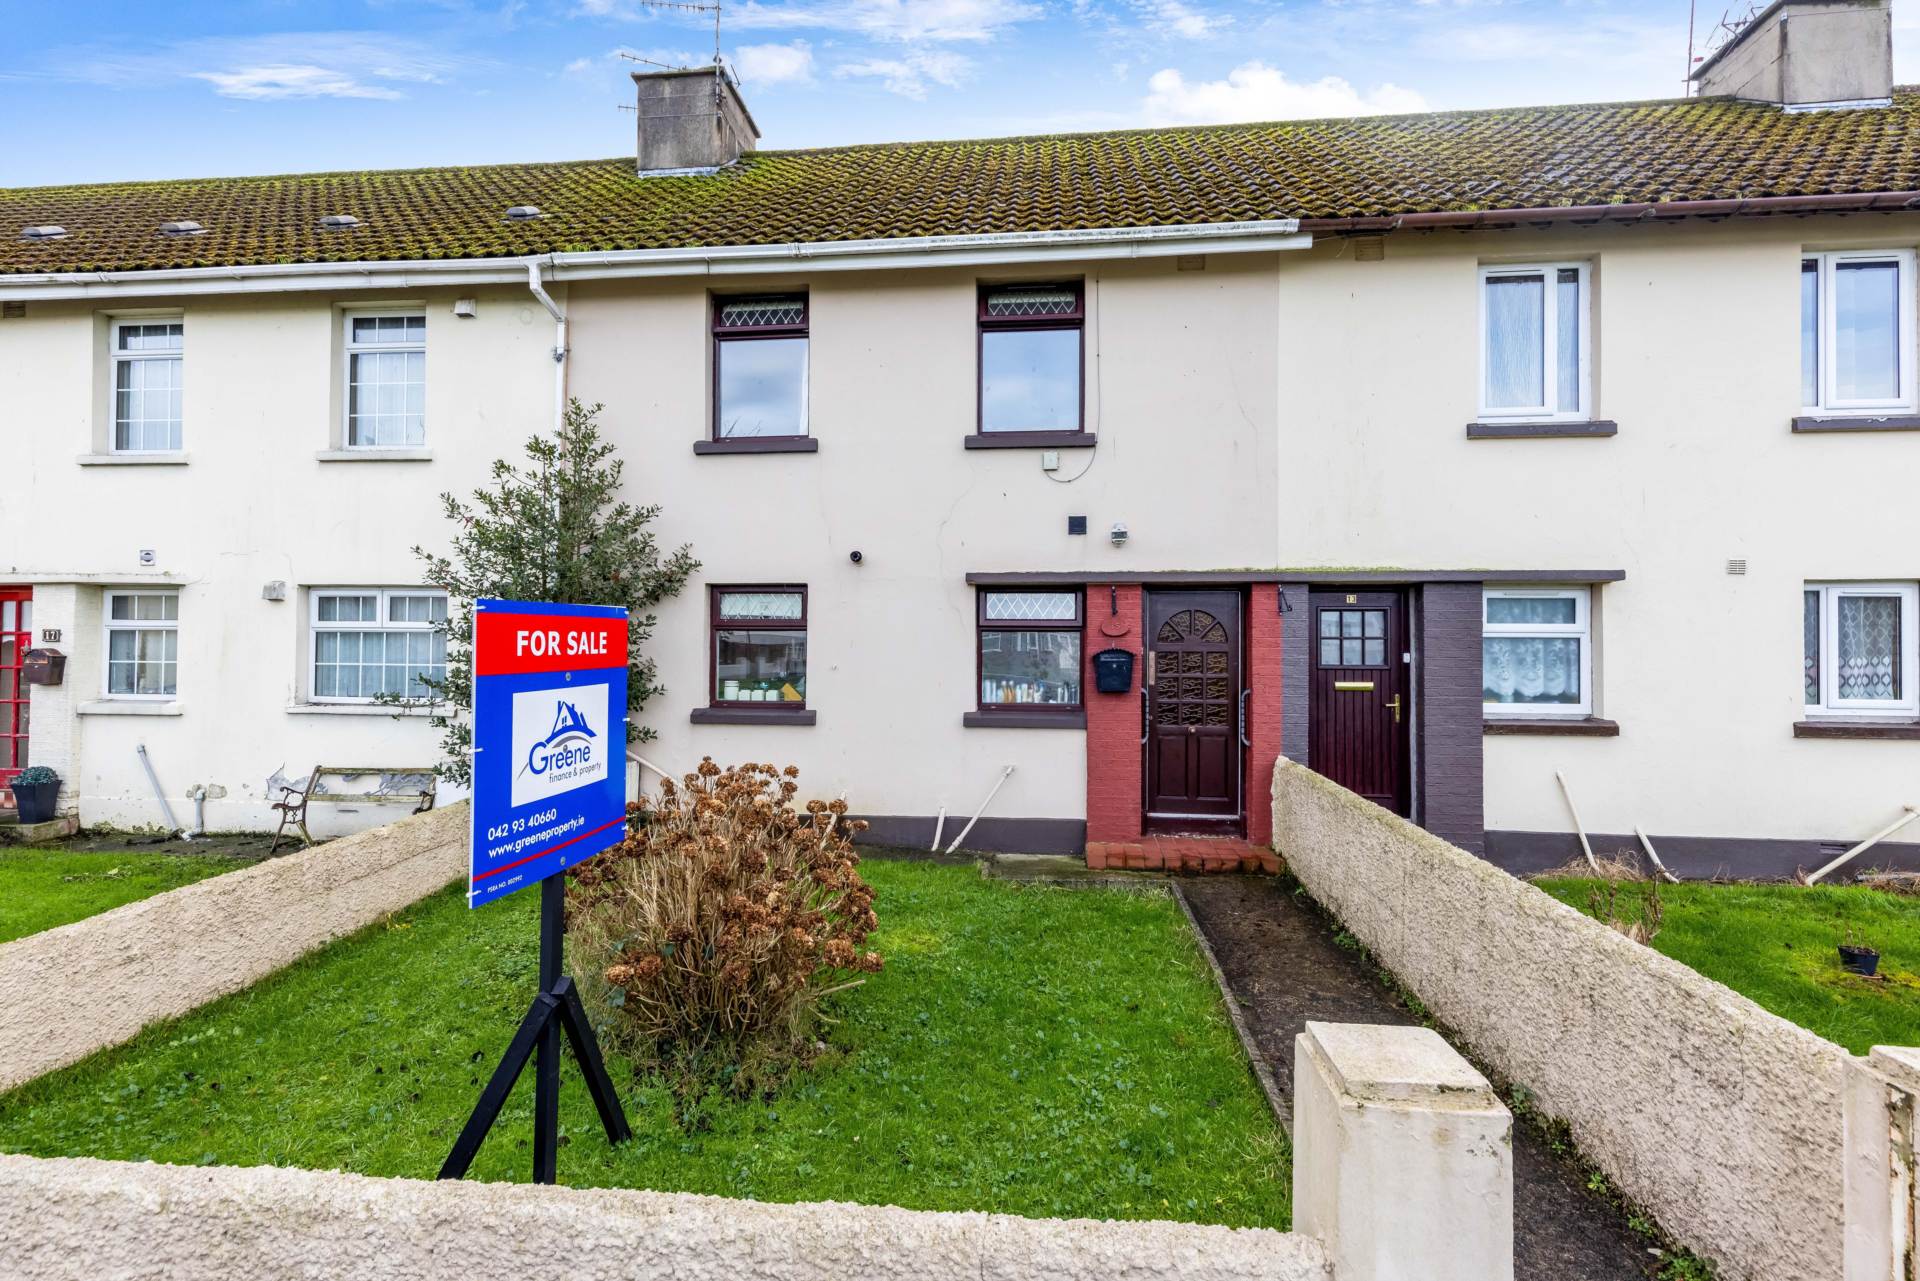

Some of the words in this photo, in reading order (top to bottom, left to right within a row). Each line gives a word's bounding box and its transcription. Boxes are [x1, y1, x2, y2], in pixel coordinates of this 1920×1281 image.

[45, 631, 55, 640] 17
[516, 630, 561, 657] FOR
[566, 631, 607, 655] SALE
[529, 741, 591, 775] Greene
[549, 770, 572, 783] finance
[573, 767, 578, 777] &
[579, 762, 602, 777] property
[488, 823, 509, 841] 042
[512, 818, 525, 834] 93
[527, 808, 557, 828] 40660
[488, 814, 585, 859] www.greeneproperty.ie
